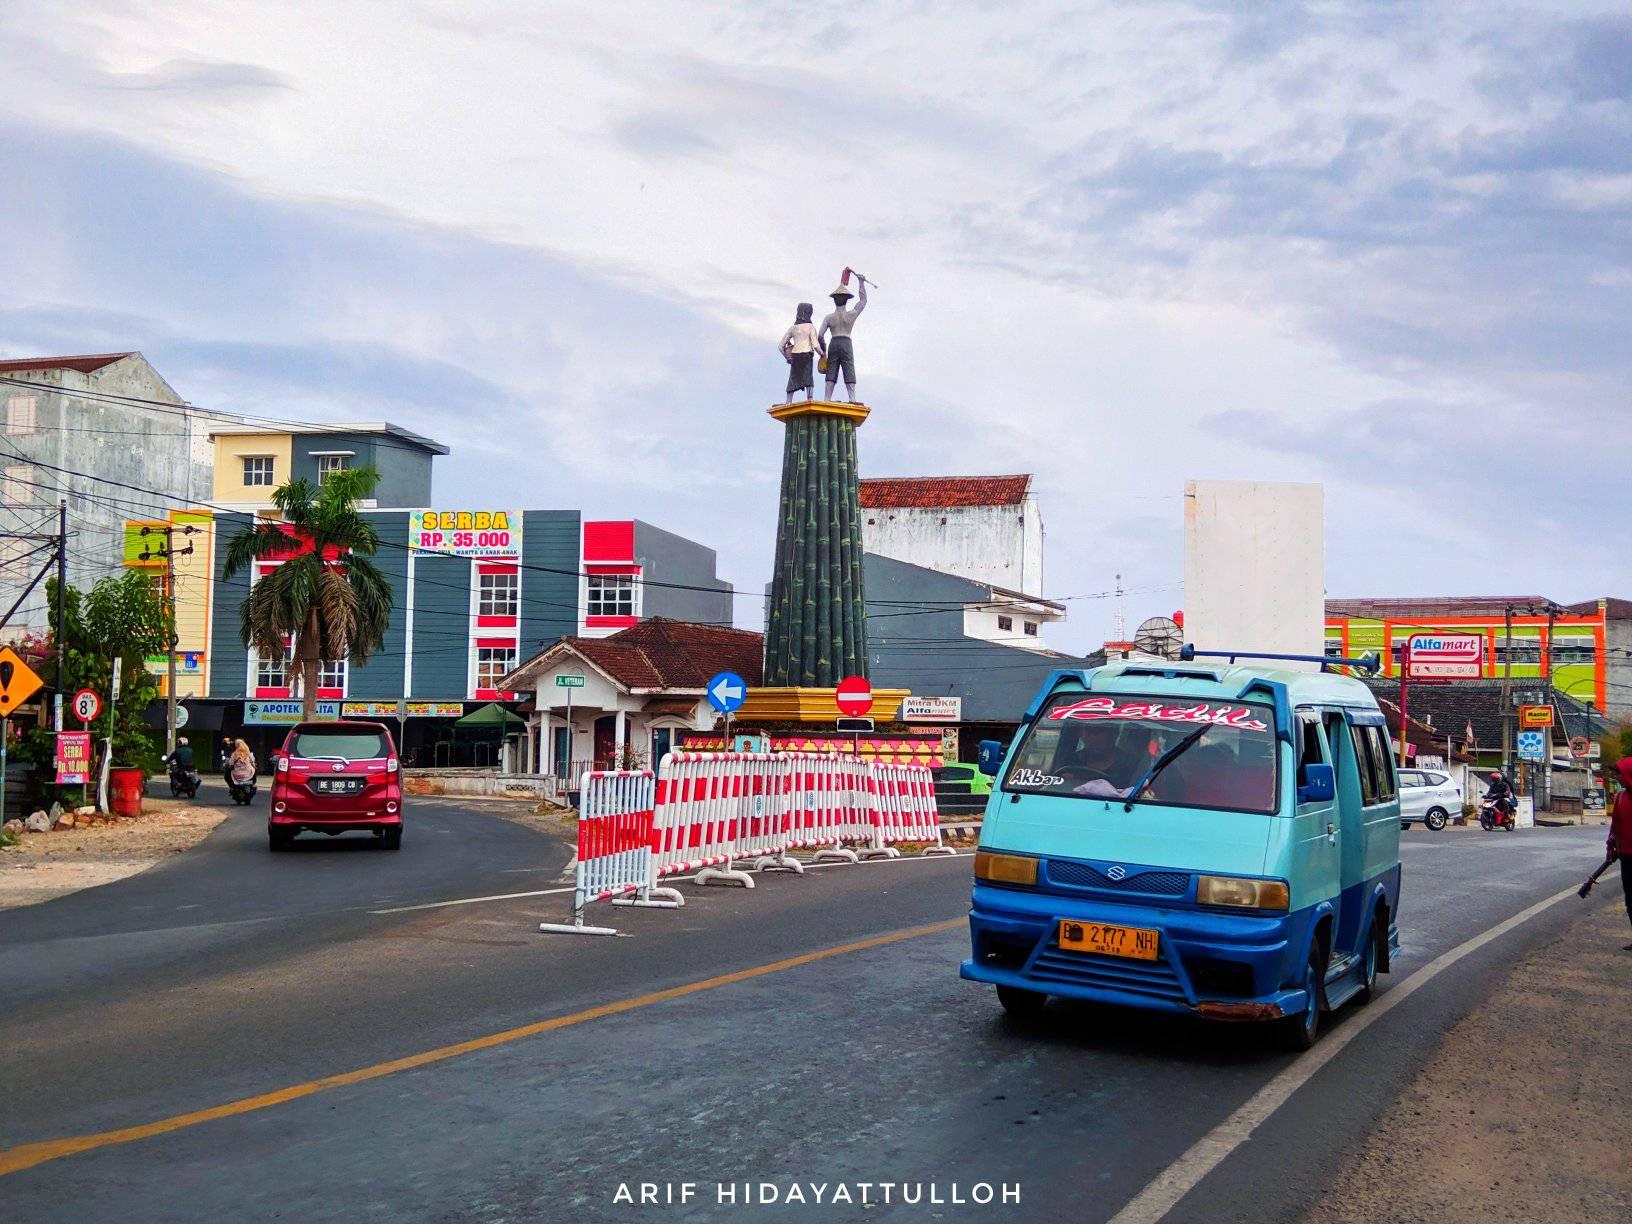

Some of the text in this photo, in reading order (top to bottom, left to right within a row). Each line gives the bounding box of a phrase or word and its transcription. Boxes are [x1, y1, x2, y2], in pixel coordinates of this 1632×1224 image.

[422, 512, 509, 530] SERBA
[420, 532, 510, 547] RP. 35.000
[1413, 638, 1477, 650] Alfamart
[80, 700, 87, 715] 8
[262, 704, 300, 713] APOTEK
[63, 746, 83, 759] SERBA
